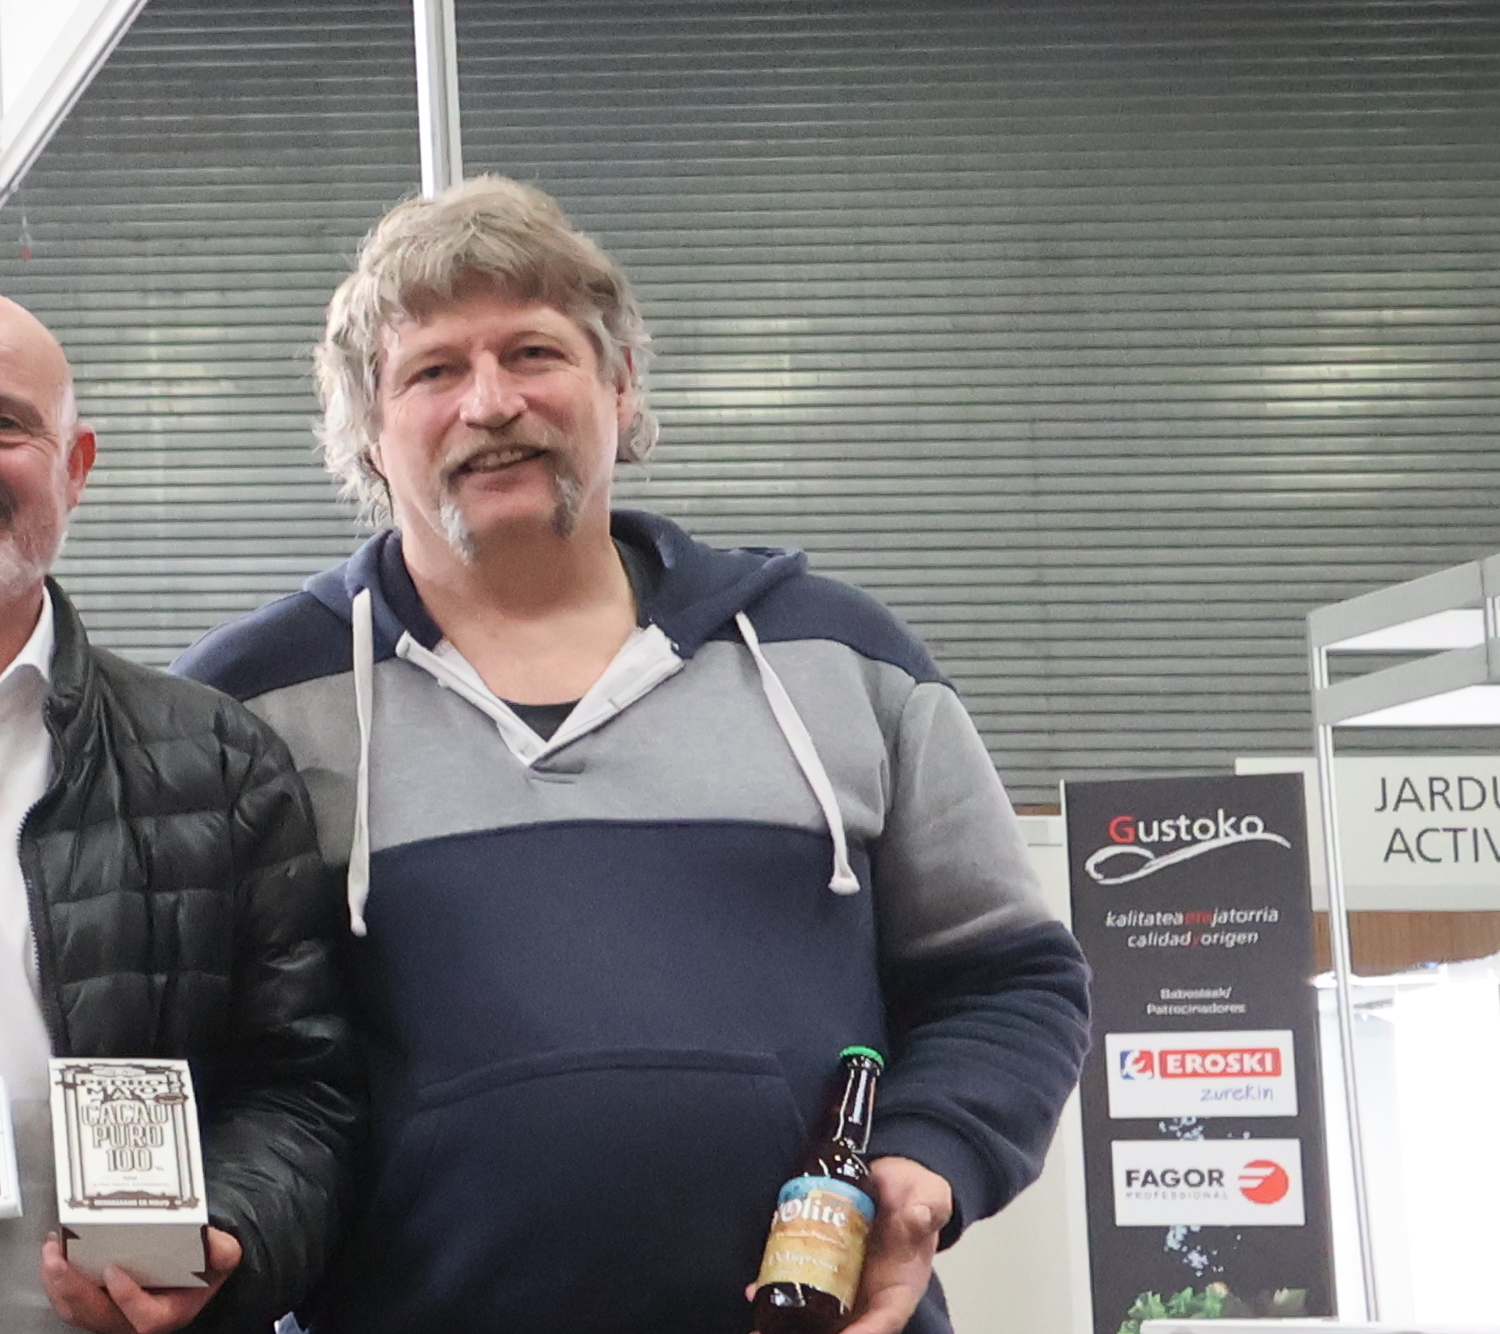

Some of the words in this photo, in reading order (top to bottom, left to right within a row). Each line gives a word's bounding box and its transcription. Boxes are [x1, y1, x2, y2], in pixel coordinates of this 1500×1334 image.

[1108, 809, 1264, 844] Gustoko
[1106, 908, 1183, 928] kalitatea
[1211, 906, 1279, 928] jatorria
[1127, 930, 1191, 948] calidad
[1200, 930, 1259, 948] origen
[1166, 1051, 1274, 1074] EROSKI
[1201, 1085, 1273, 1102] zurekin
[81, 1102, 169, 1126] CACAO
[92, 1124, 164, 1148] PURO
[1126, 1169, 1224, 1189] FAGOR
[780, 1197, 847, 1229] Olite
